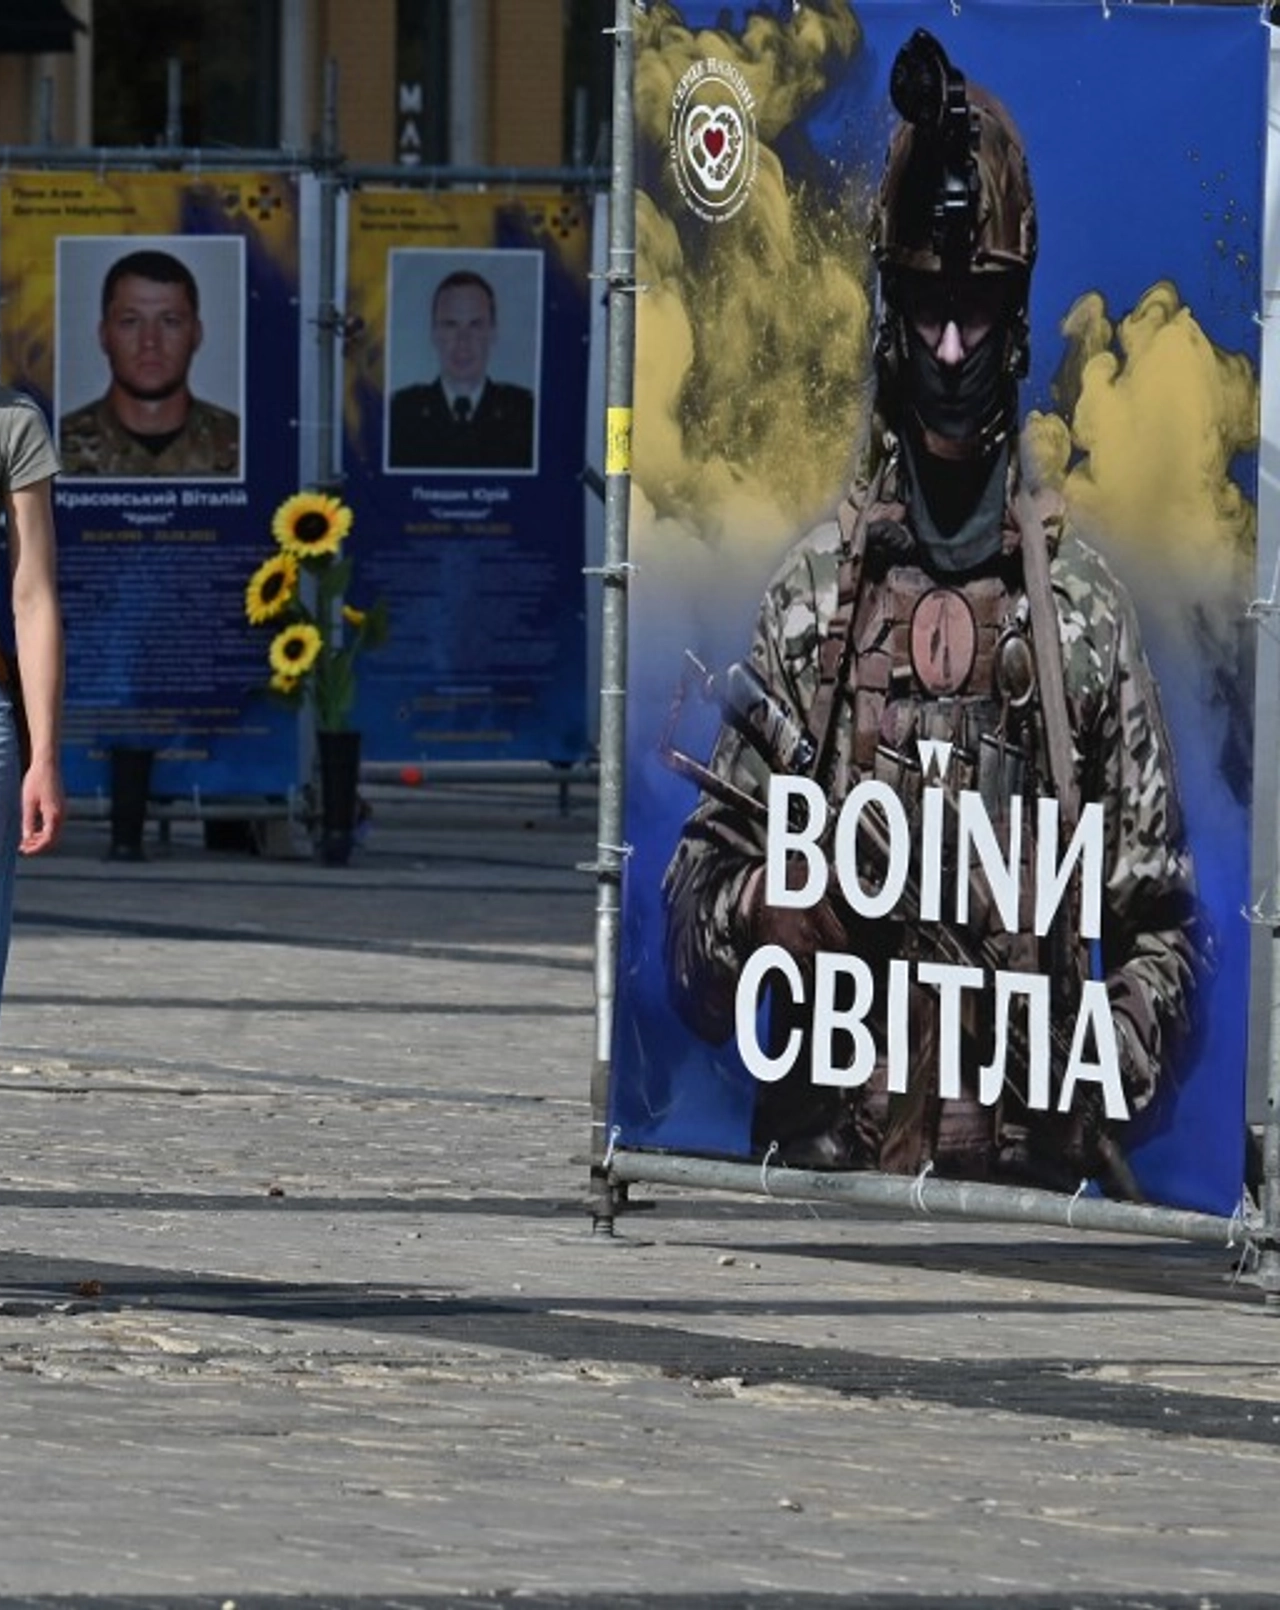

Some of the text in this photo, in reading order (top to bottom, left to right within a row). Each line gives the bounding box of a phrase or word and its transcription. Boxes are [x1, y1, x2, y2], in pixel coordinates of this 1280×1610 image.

[399, 82, 423, 164] МА
[55, 489, 248, 508] Красовський Віталій
[734, 944, 1132, 1121] СВІТЛА
